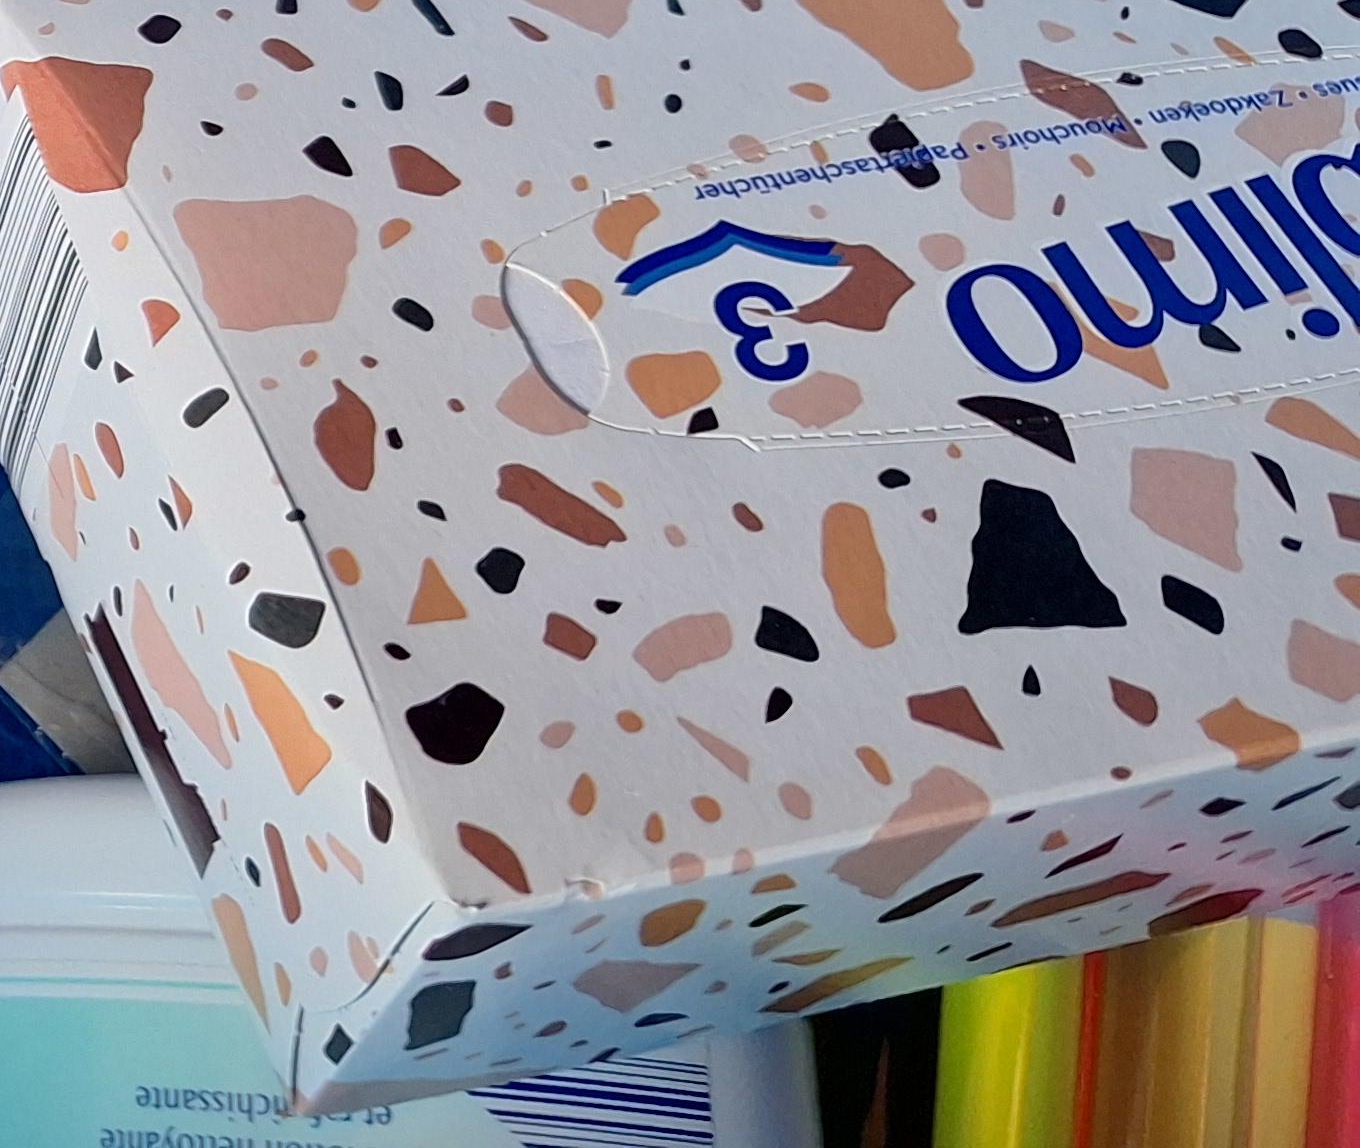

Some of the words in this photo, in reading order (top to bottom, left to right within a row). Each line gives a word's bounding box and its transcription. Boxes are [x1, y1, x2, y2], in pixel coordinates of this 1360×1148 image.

[1149, 87, 1288, 128] Zakdoeken
[992, 115, 1126, 152] Mouchoirs
[694, 141, 968, 204] Papiertaschentücher
[714, 281, 809, 381] 3
[362, 1106, 392, 1126] et
